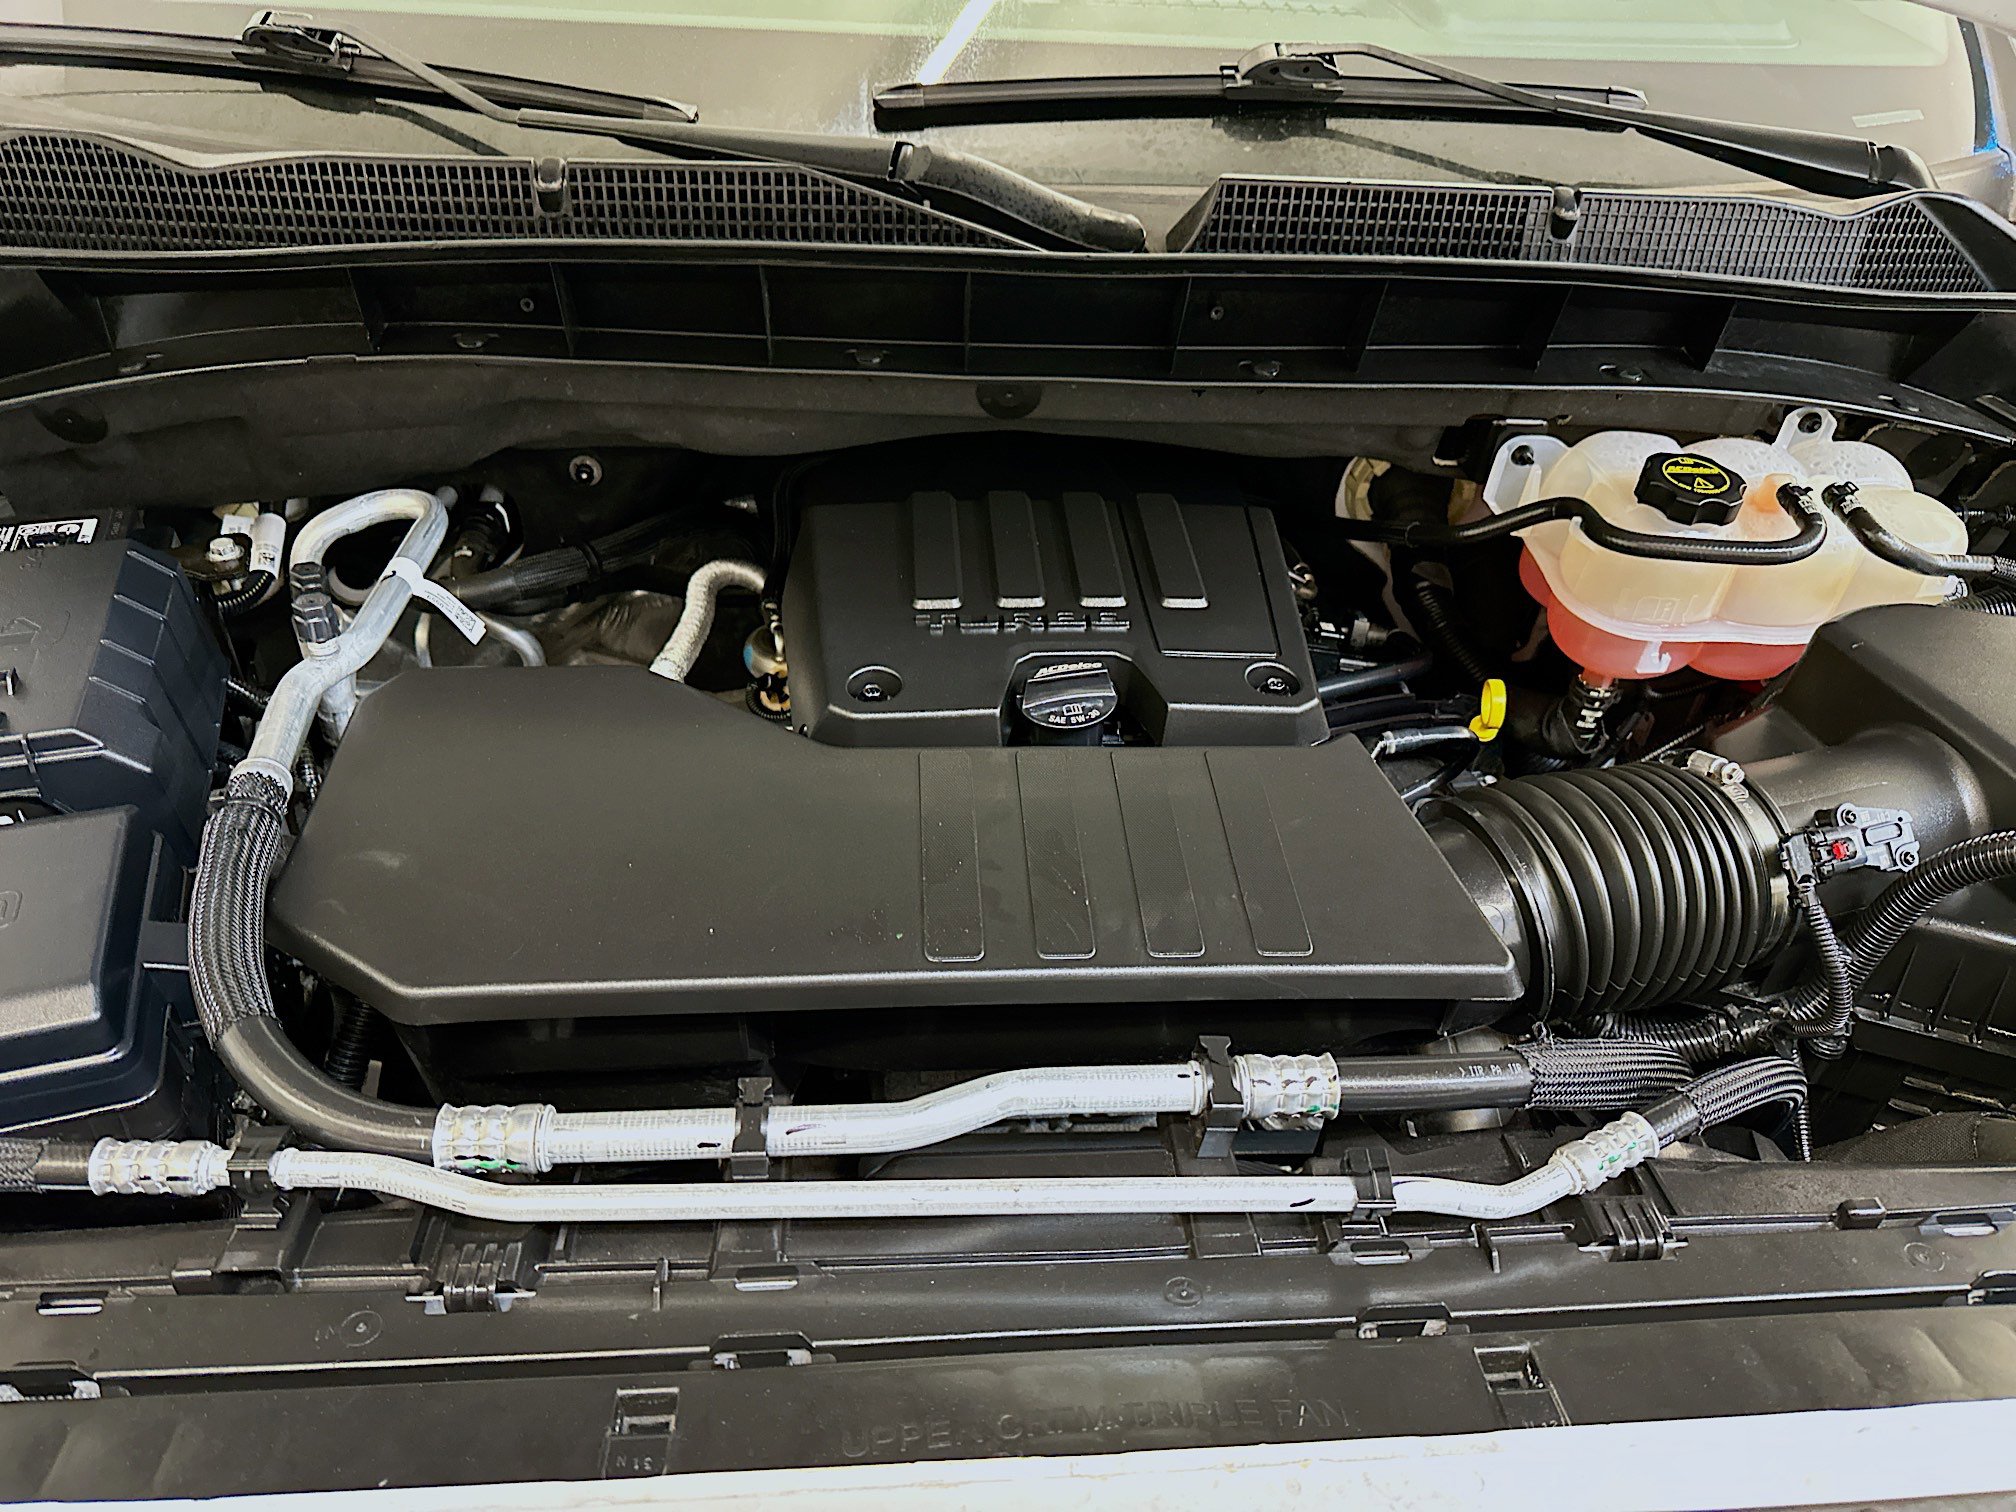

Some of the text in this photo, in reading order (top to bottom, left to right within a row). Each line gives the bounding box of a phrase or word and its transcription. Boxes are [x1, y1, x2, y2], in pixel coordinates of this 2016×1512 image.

[1033, 661, 1103, 679] ACDelco
[1048, 708, 1101, 725] SAE 5W-30
[1268, 1399, 1349, 1428] FAN
